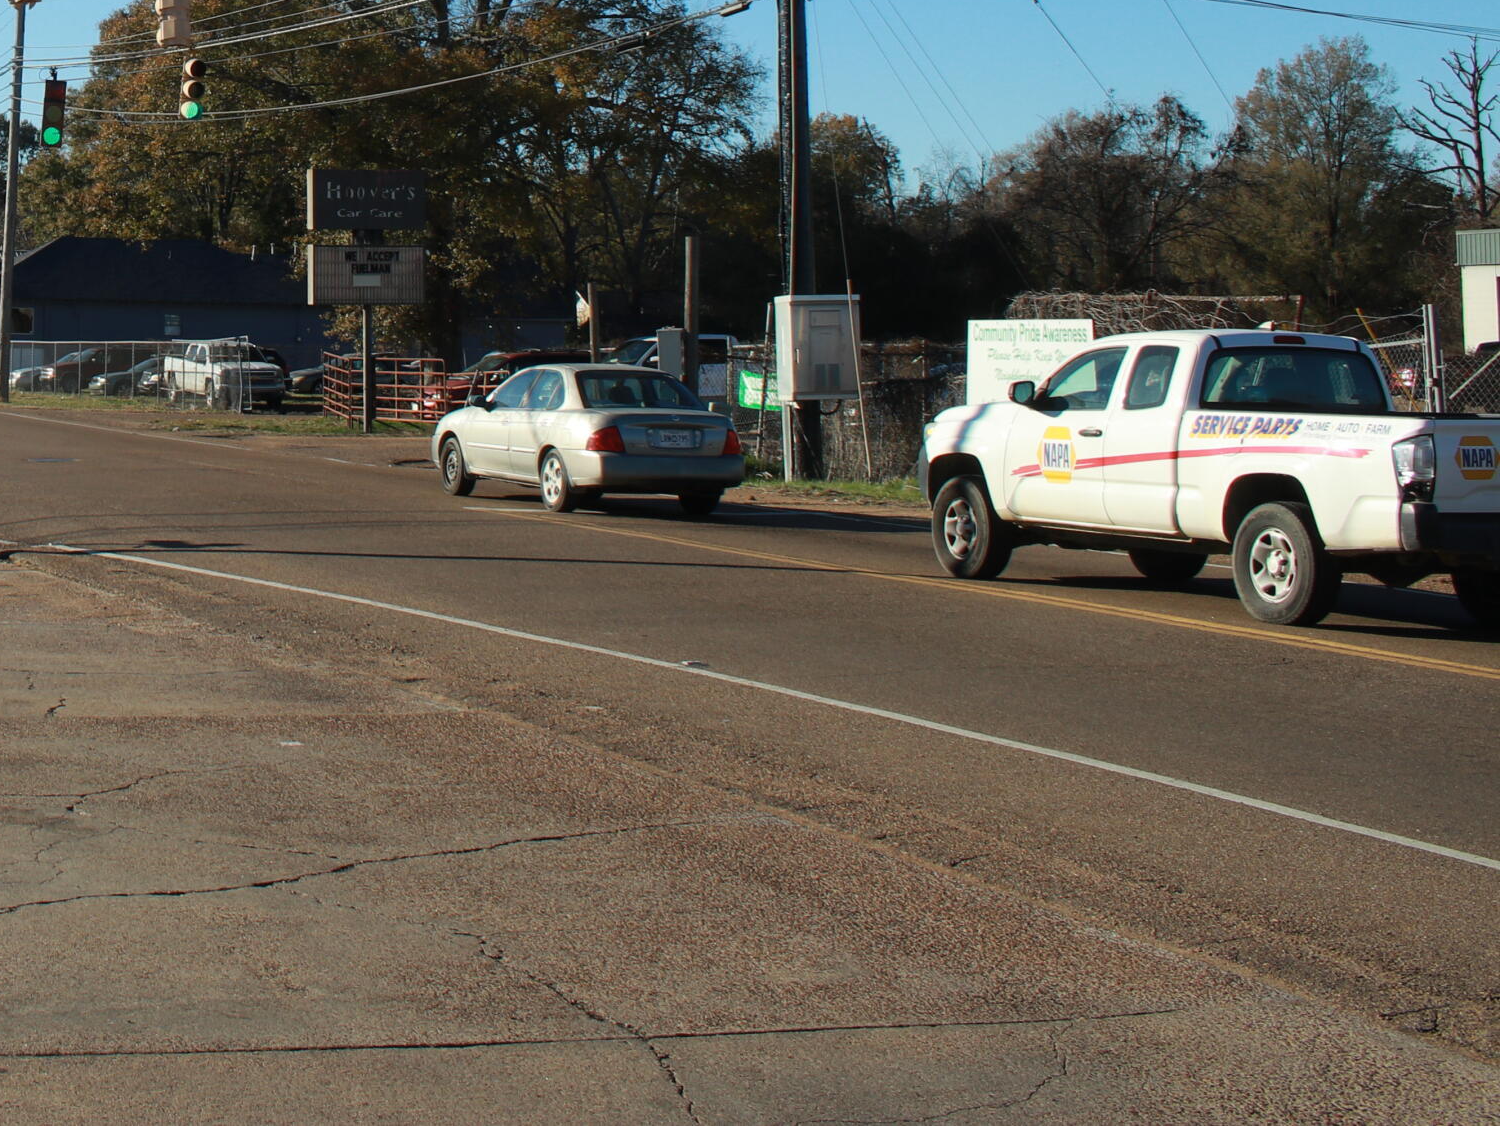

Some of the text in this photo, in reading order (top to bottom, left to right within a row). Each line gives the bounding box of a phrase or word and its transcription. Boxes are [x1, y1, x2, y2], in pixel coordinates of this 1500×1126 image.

[336, 208, 404, 218] Car Care
[344, 251, 399, 262] WE ACCEPT
[351, 263, 391, 274] FUELMAN
[973, 323, 1088, 347] Community Pride Awareness
[1189, 414, 1252, 437] SERVICE
[1250, 416, 1304, 438] PARTS
[1306, 421, 1331, 432] HOME
[1336, 422, 1359, 433] AUTO
[1365, 424, 1392, 435] FARM
[1043, 442, 1070, 468] NAPA
[1462, 448, 1494, 468] NAPA
